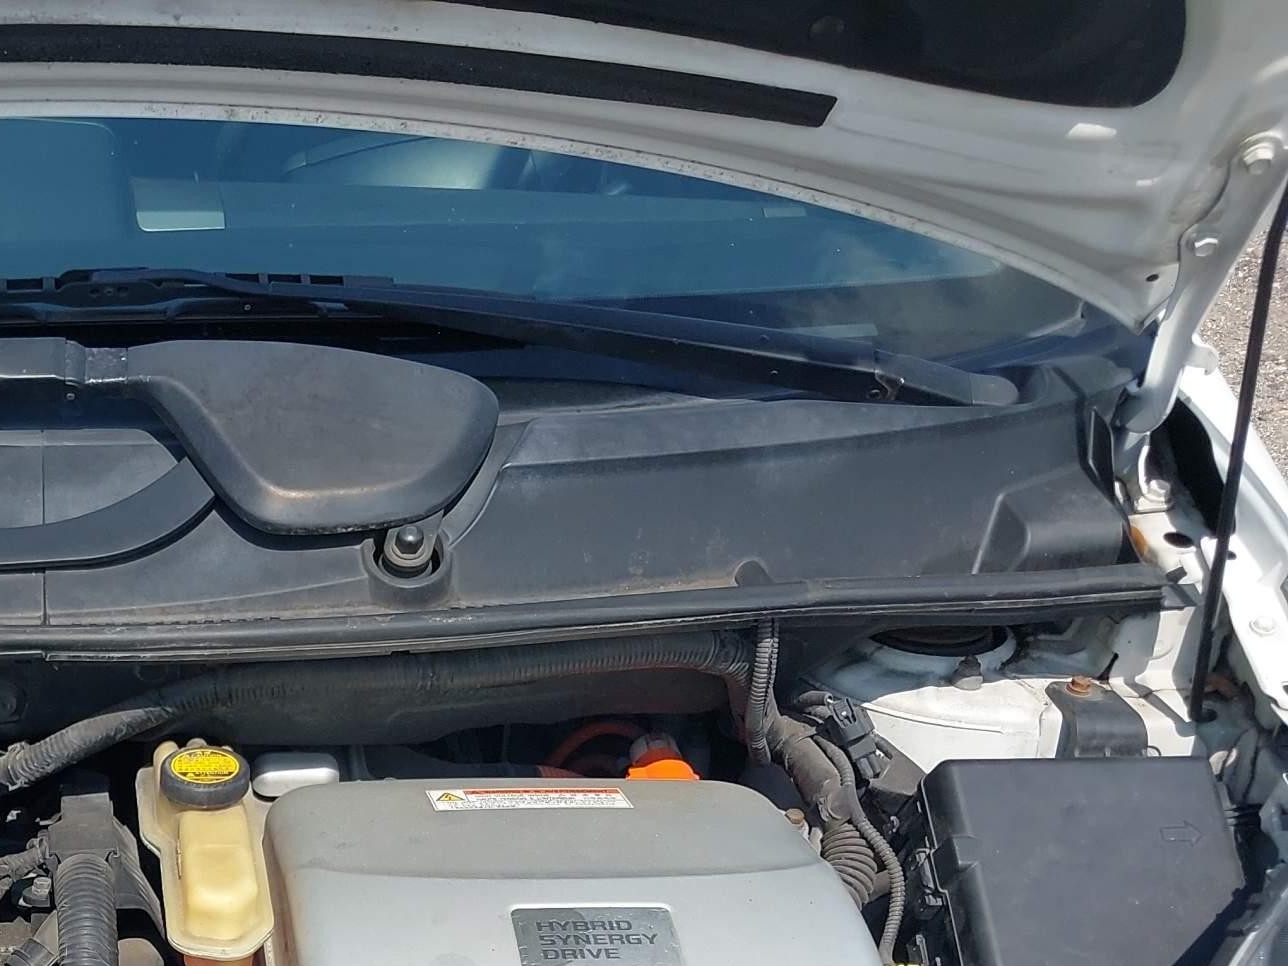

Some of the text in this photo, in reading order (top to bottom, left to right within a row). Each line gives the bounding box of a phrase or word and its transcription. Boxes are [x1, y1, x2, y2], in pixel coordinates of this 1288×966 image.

[535, 920, 633, 932] HYBRID
[538, 932, 659, 946] SYNERGY
[541, 947, 621, 960] DRIVE
